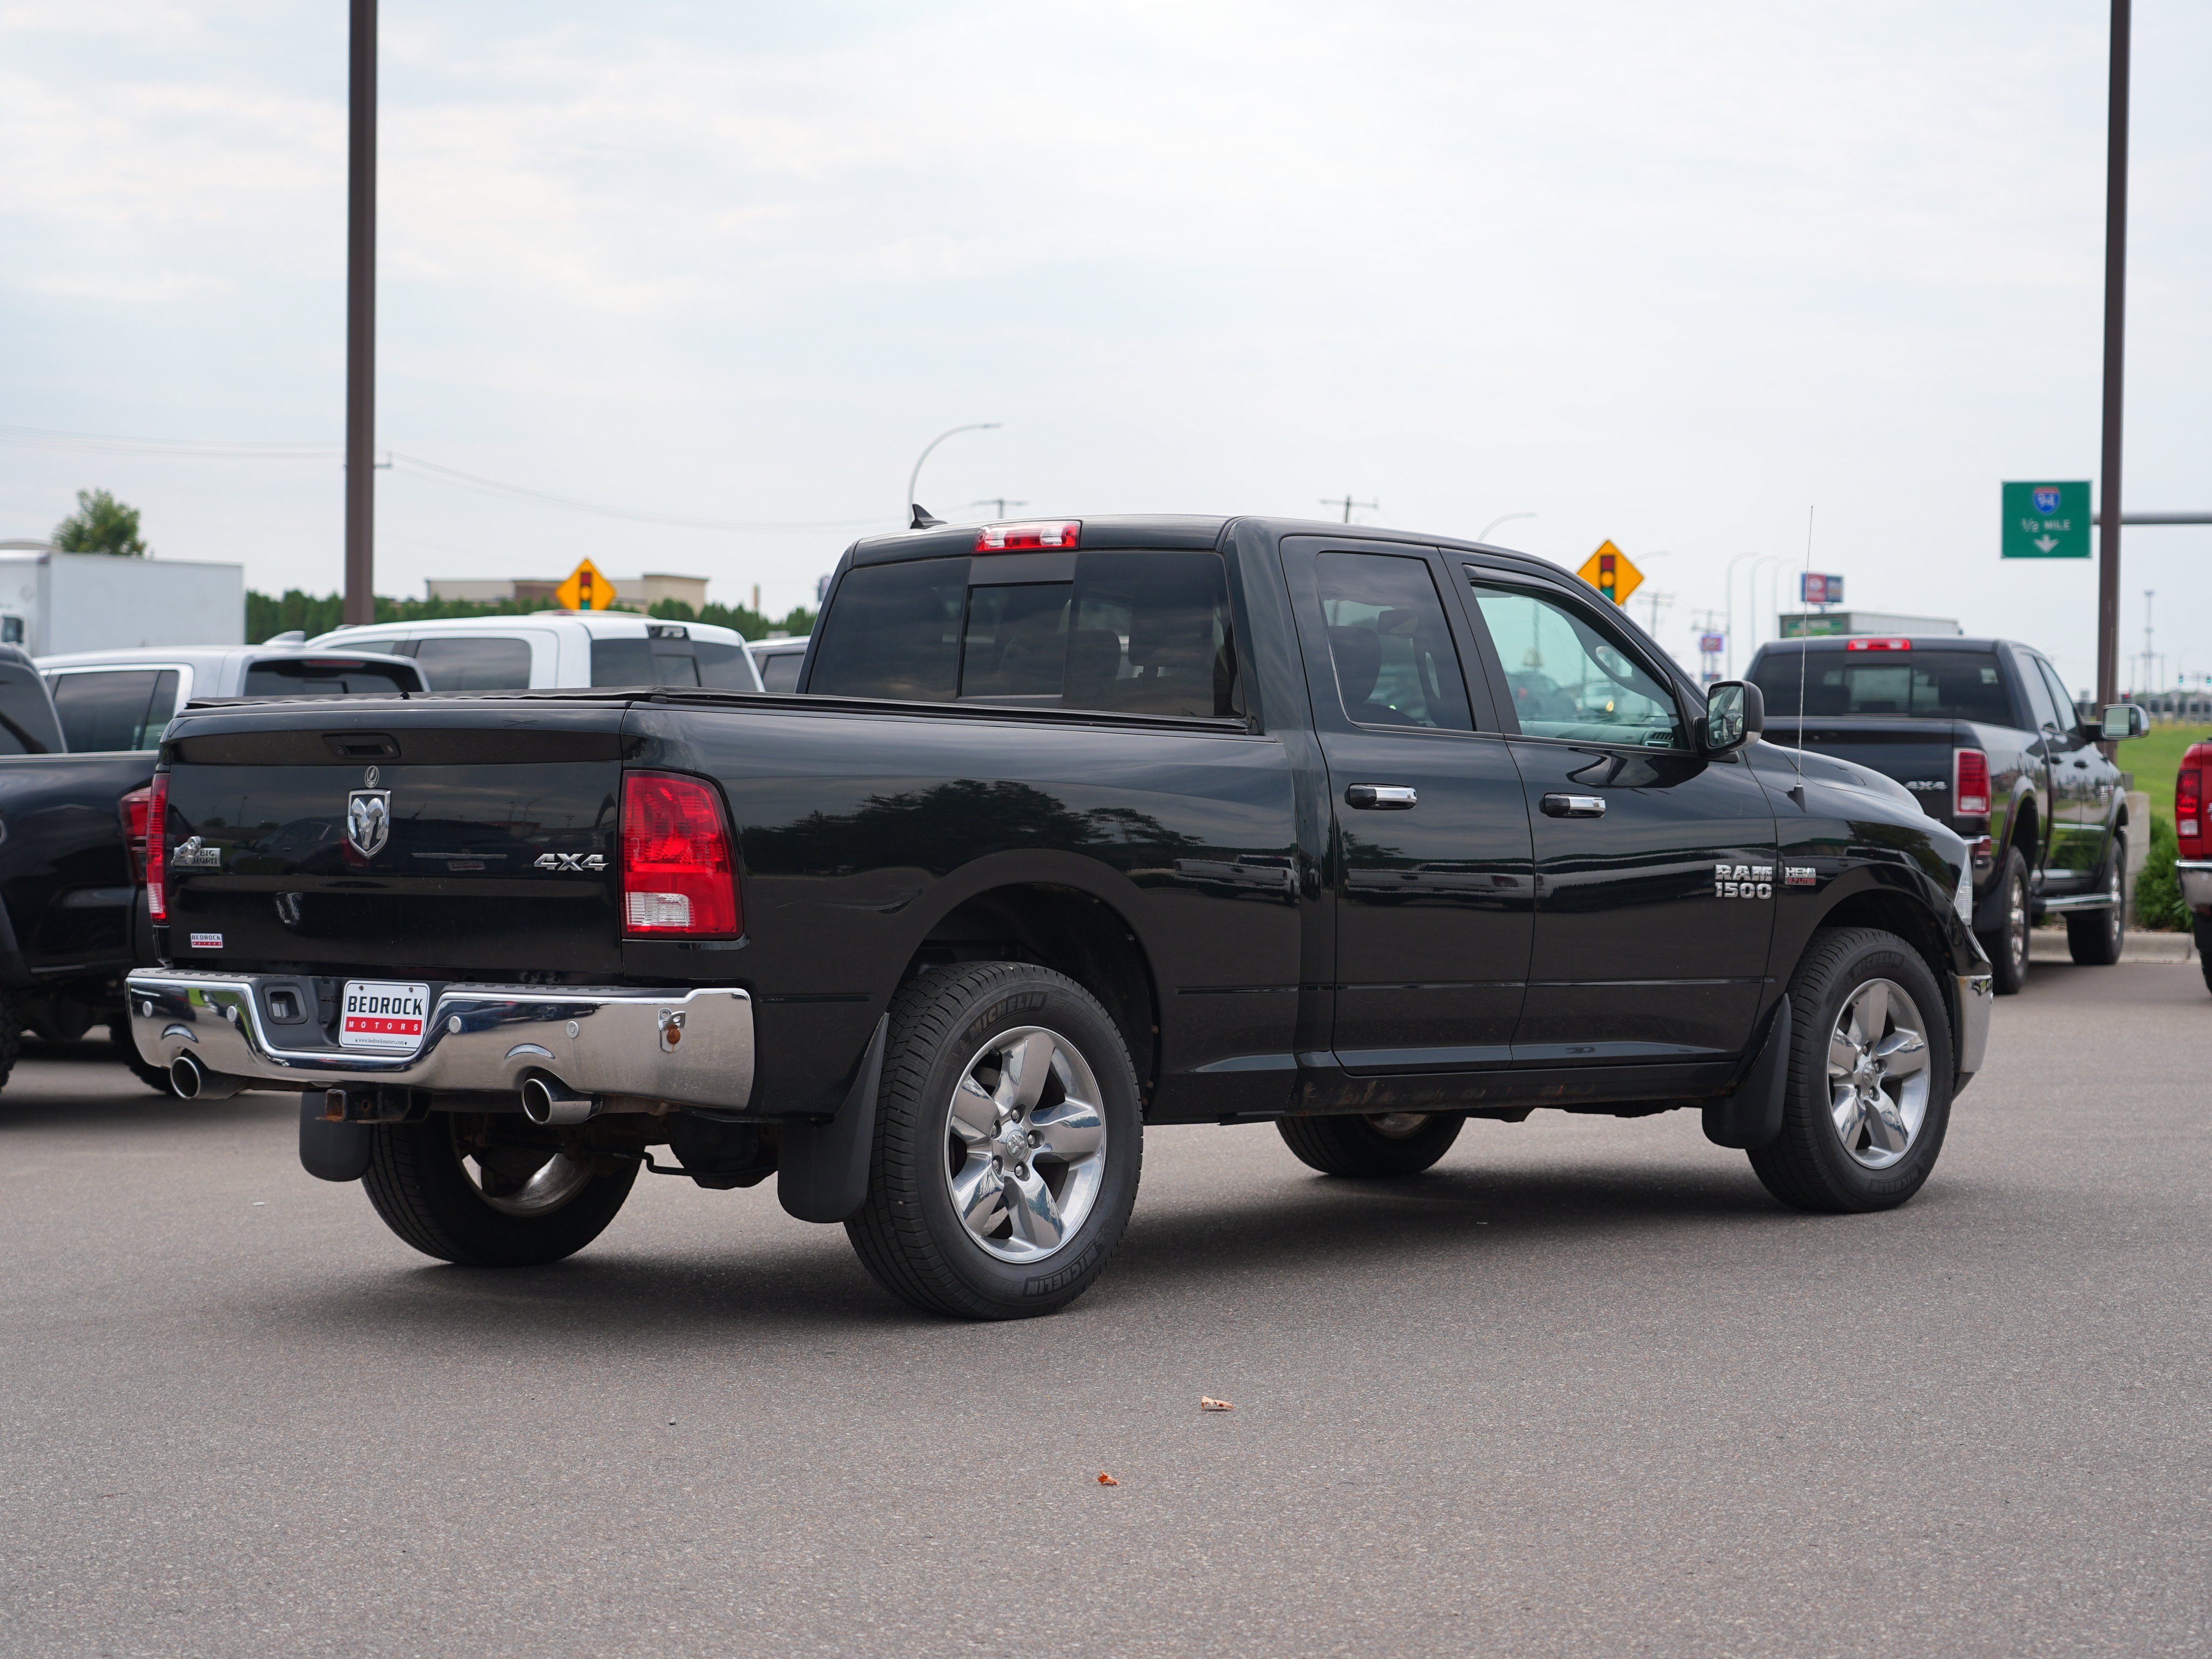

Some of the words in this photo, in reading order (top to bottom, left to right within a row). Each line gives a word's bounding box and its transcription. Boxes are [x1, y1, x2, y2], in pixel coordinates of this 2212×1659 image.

[2038, 494, 2055, 507] 94
[2044, 519, 2071, 530] MILE
[534, 853, 609, 871] 4X4
[1715, 864, 1772, 881] RAM
[1785, 867, 1816, 878] HEMI
[1715, 882, 1772, 899] 1500
[347, 996, 422, 1015] BEDROCK
[970, 994, 1044, 1035] MICHELIN
[349, 1021, 419, 1031] MOTORS
[1027, 1245, 1098, 1294] MICHELIN
